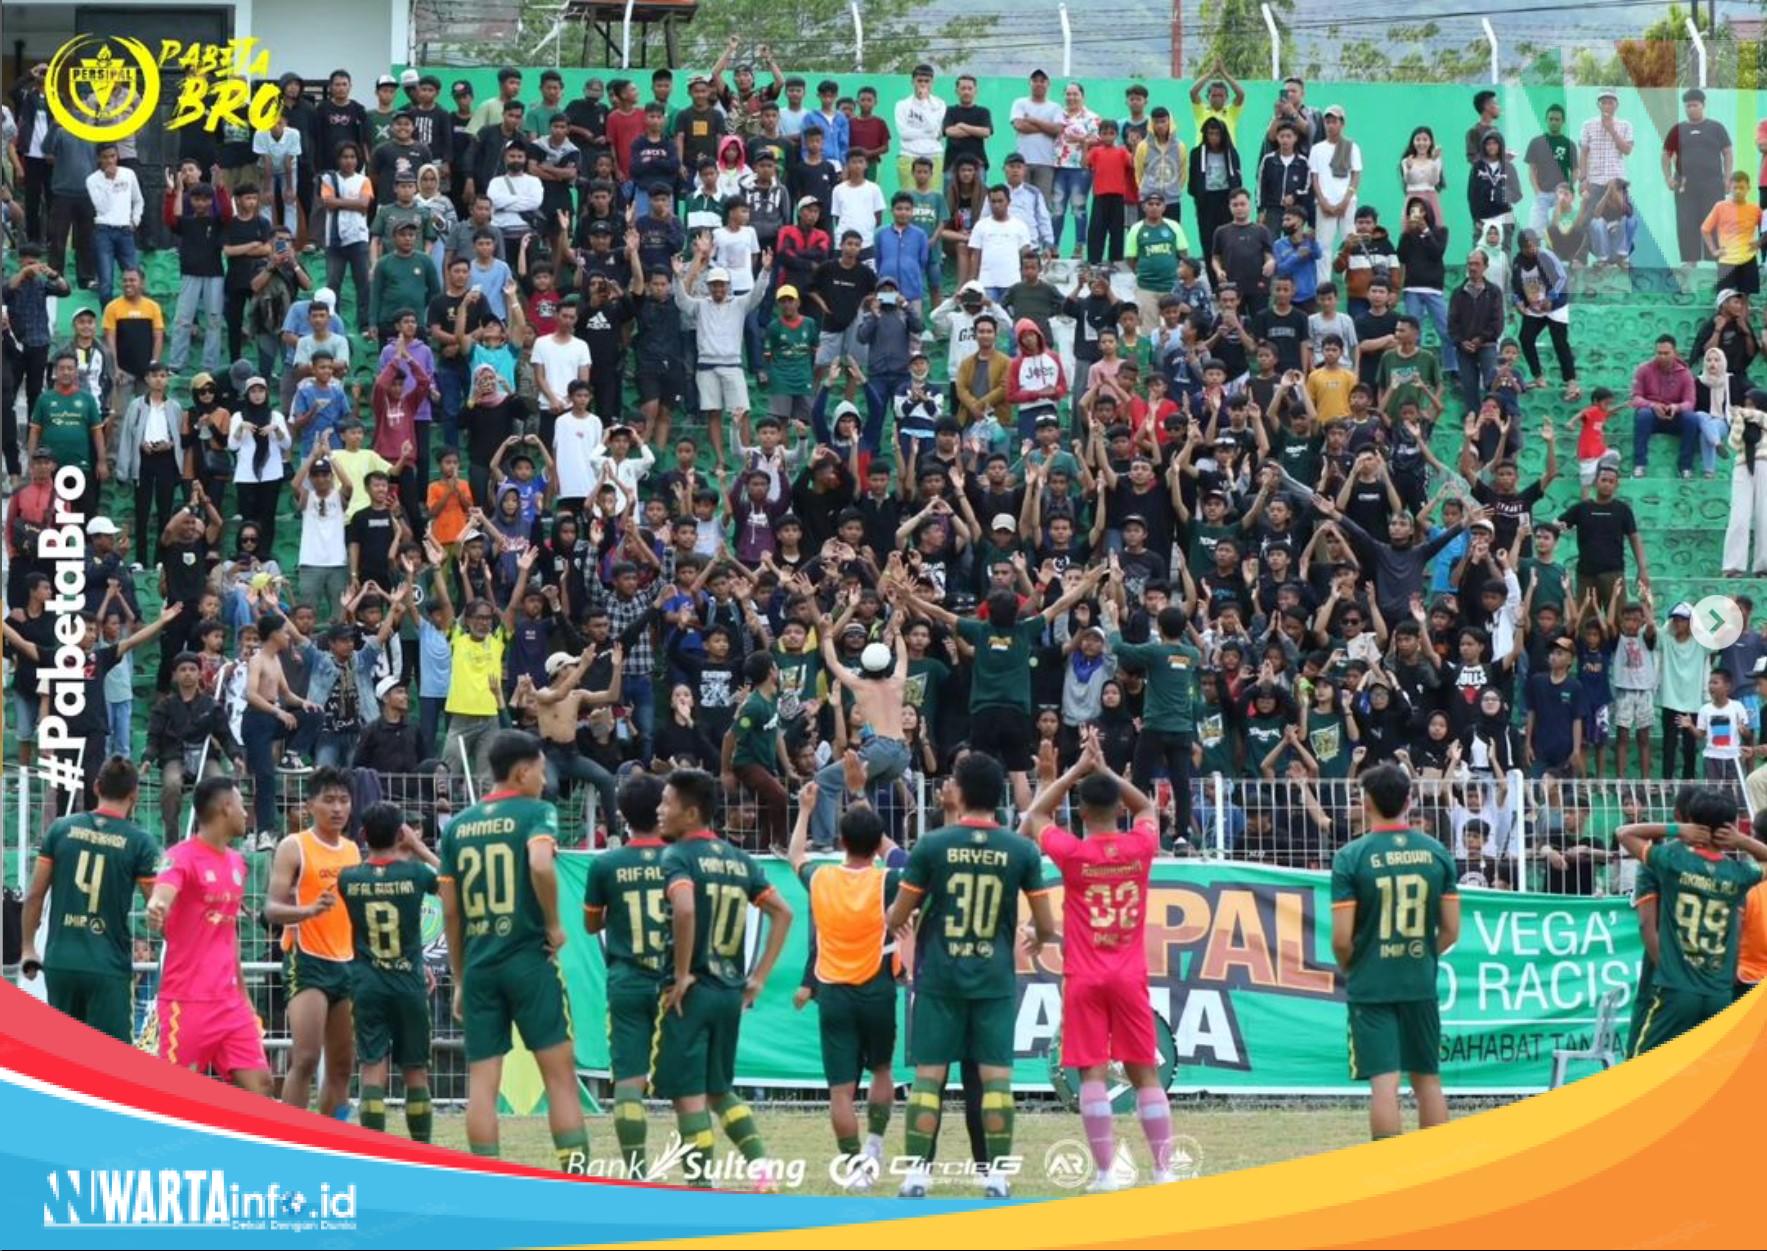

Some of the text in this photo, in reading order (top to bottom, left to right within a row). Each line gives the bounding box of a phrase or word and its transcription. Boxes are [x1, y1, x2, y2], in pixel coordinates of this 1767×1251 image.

[456, 820, 516, 839] AHMED
[946, 847, 1009, 868] BRYEN
[75, 850, 106, 914] 4
[457, 843, 516, 918] 20
[944, 873, 1004, 939] 30
[1376, 873, 1429, 941] 18
[365, 901, 402, 960] 8
[707, 883, 748, 957] 10
[1478, 960, 1643, 1011] RACIS
